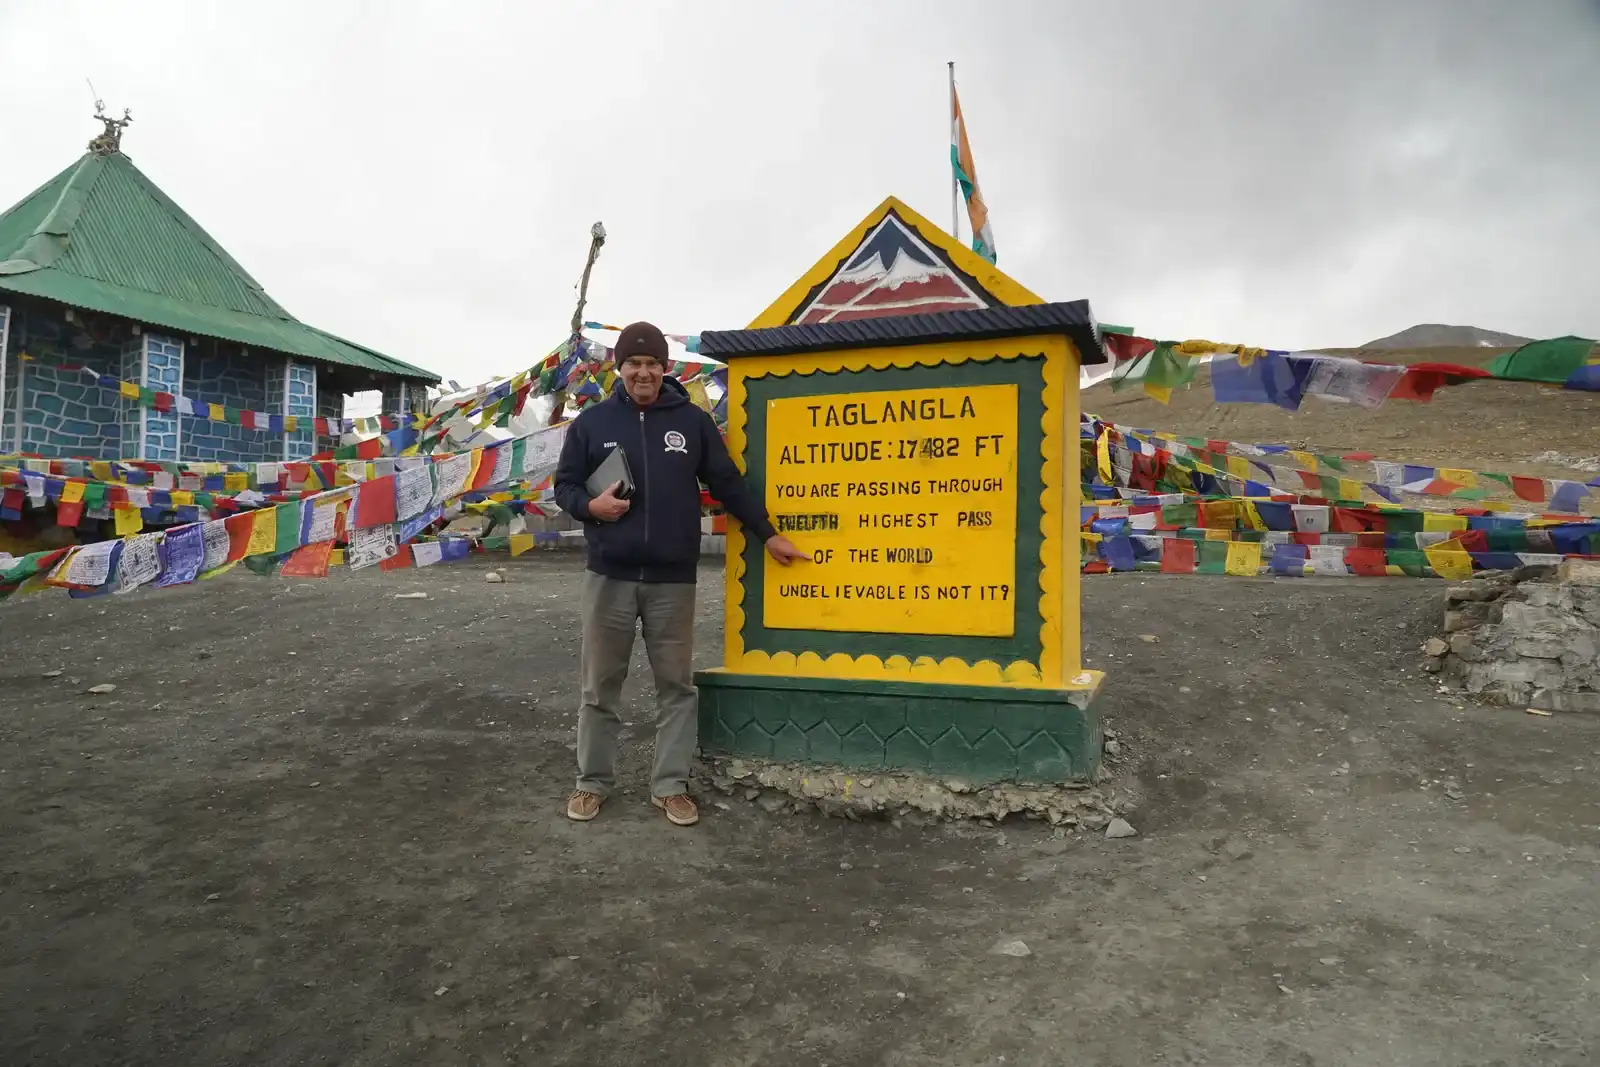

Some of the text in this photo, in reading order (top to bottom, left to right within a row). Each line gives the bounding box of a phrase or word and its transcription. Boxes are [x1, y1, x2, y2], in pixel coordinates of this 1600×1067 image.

[808, 395, 976, 428] TAGLANGLA
[975, 435, 1004, 456] FT
[776, 478, 1002, 499] YOU ARE PASSING THROUGH
[775, 511, 992, 532] TWELFTH HIGHEST PASS
[813, 548, 933, 564] OF THE WORLD
[779, 584, 905, 600] UNBELIEVABLE
[914, 585, 930, 599] IS
[938, 585, 972, 600] NOT
